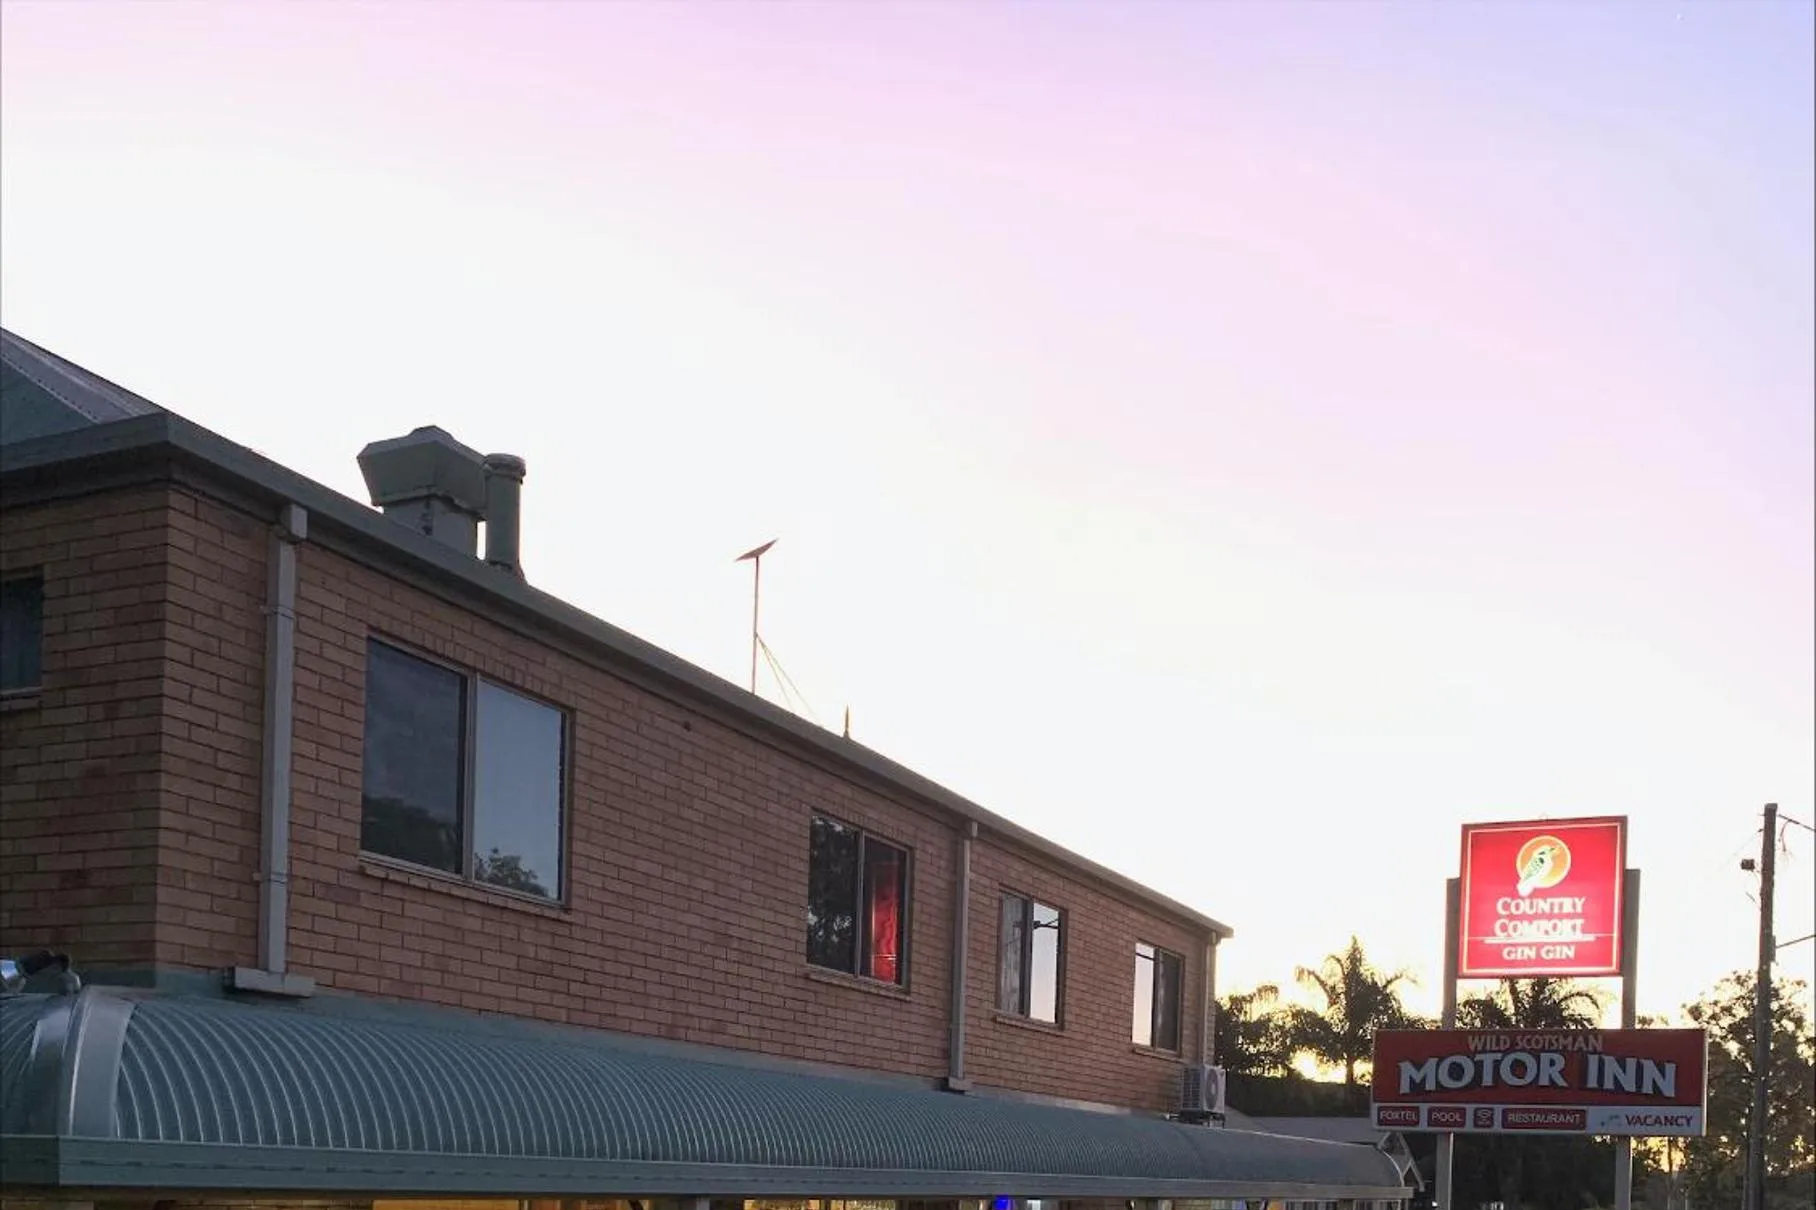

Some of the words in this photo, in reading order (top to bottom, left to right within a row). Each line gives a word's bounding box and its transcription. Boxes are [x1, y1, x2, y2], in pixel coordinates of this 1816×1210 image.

[1496, 897, 1586, 915] COUNTRY
[1502, 945, 1536, 960] GIN
[1540, 944, 1576, 959] GIN
[1468, 1034, 1510, 1050] WILD
[1514, 1034, 1602, 1051] SCOTSMAN
[1398, 1052, 1569, 1095] MOTOR
[1586, 1054, 1676, 1098] INN
[1431, 1111, 1464, 1122] POOL
[1507, 1113, 1581, 1124] RESTAURANT
[1625, 1114, 1693, 1127] VACANCY
